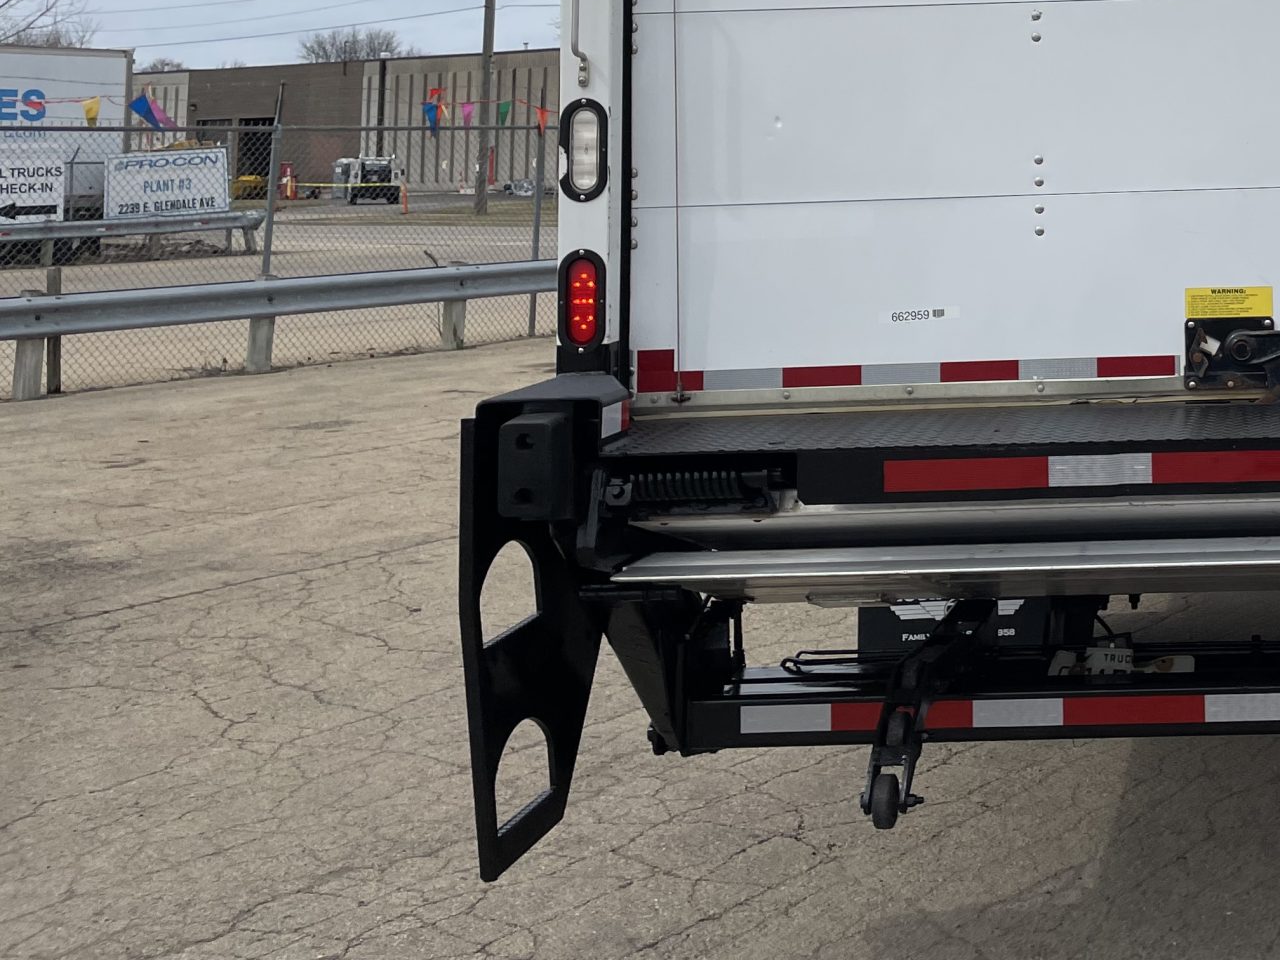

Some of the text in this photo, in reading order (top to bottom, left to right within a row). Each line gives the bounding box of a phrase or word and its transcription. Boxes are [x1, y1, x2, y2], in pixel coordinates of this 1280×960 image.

[10, 167, 63, 178] TRUCKS
[143, 179, 175, 194] PLANT
[118, 203, 140, 215] 2239
[154, 198, 197, 212] GLENDALE
[891, 309, 930, 322] 662959
